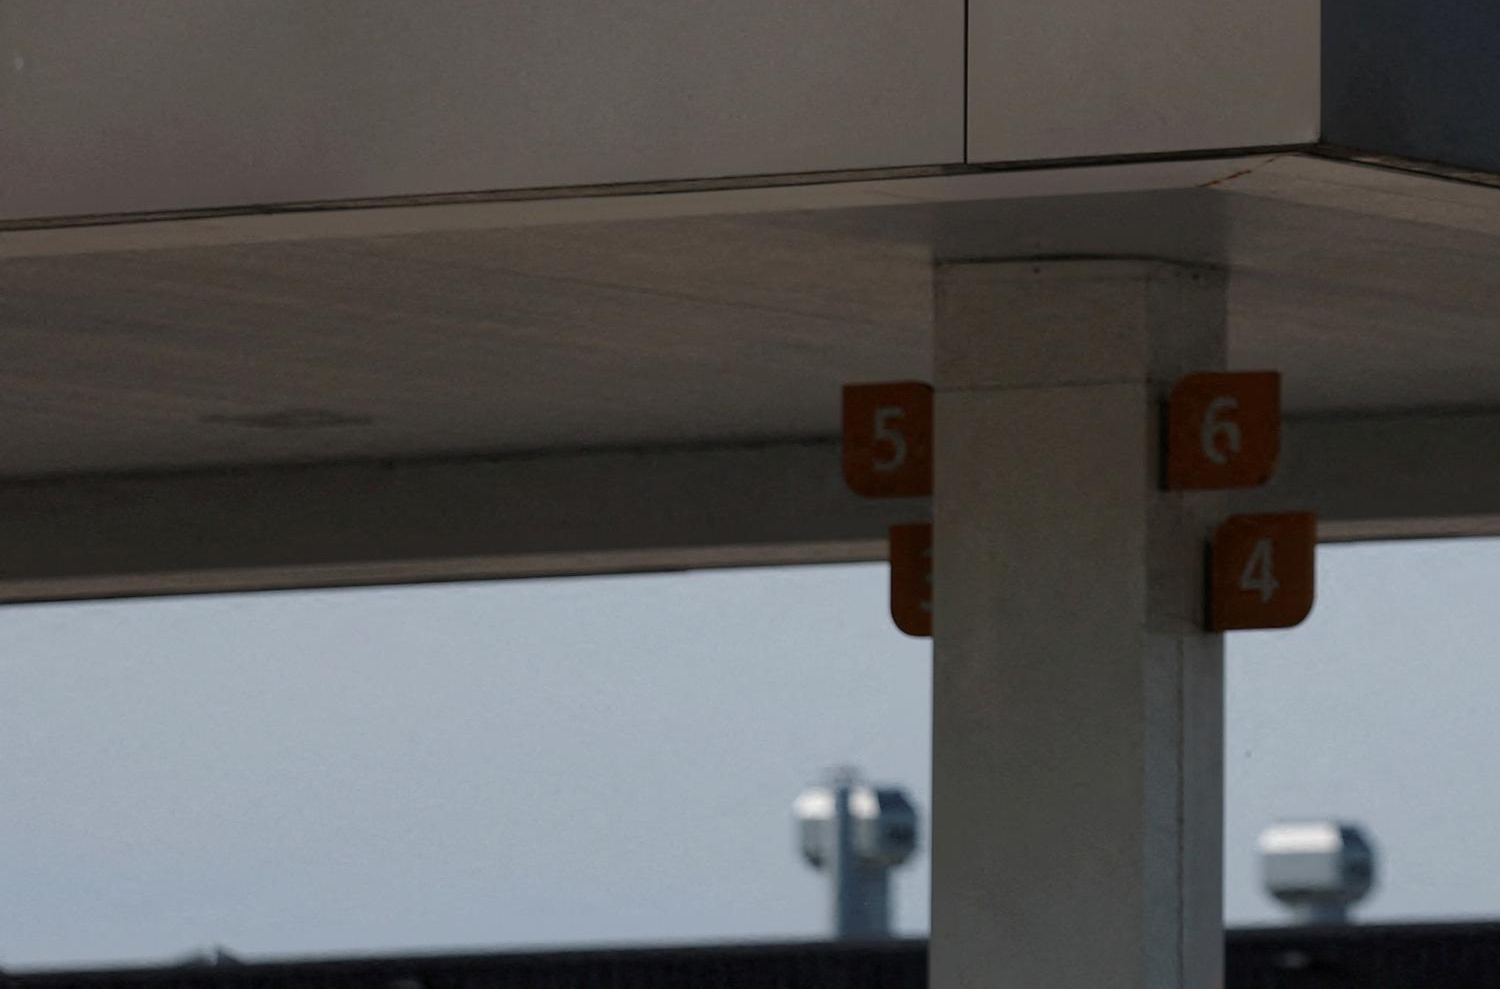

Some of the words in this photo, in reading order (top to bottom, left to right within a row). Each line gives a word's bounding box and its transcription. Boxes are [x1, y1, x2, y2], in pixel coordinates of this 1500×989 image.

[871, 406, 908, 472] 5
[1203, 395, 1243, 465] 6
[1239, 536, 1280, 604] 4
